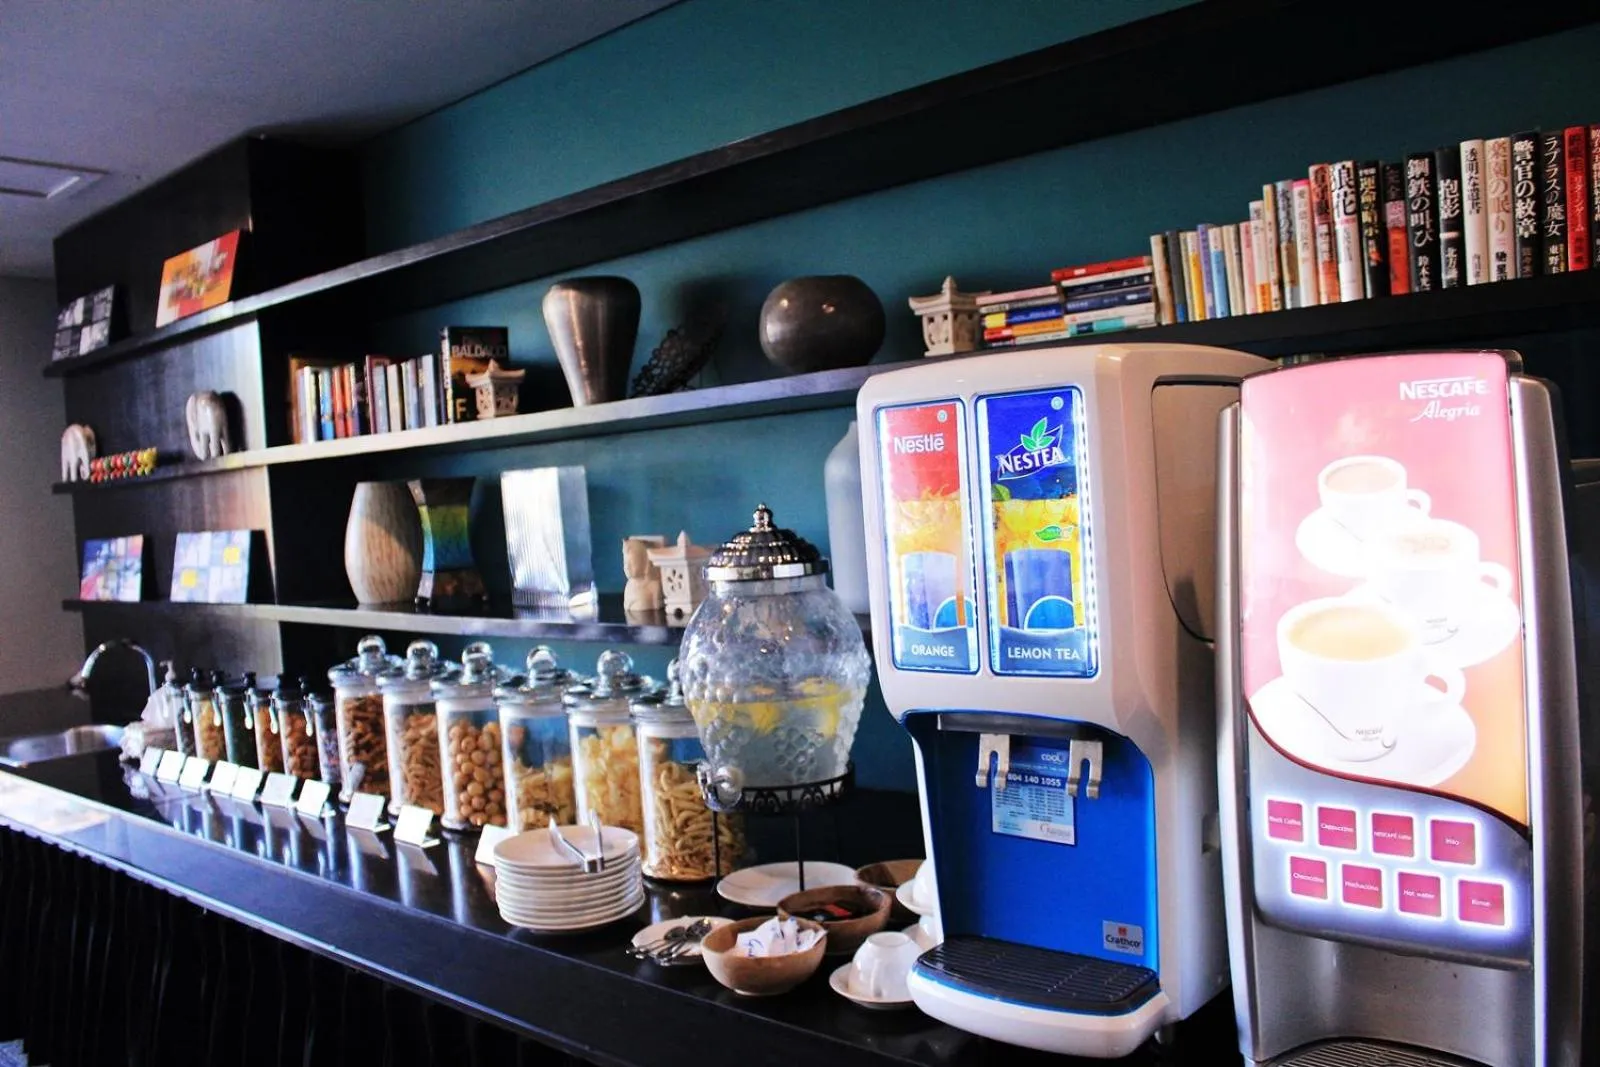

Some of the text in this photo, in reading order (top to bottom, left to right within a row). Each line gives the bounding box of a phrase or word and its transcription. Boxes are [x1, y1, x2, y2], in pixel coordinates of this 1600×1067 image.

[1513, 140, 1537, 239] 警官の紋章
[1544, 136, 1565, 237] ラプラスの魔女
[1407, 158, 1434, 248] 鋼鉄の叫び
[1438, 179, 1460, 220] 抱影
[1410, 400, 1481, 422] Alegria
[894, 432, 945, 456] Nestlé
[996, 446, 1064, 474] NESTEA
[911, 644, 955, 657] ORANGE
[1007, 646, 1081, 660] LEMON TEA
[1041, 777, 1061, 787] 1055
[1105, 934, 1141, 948] Crathco
